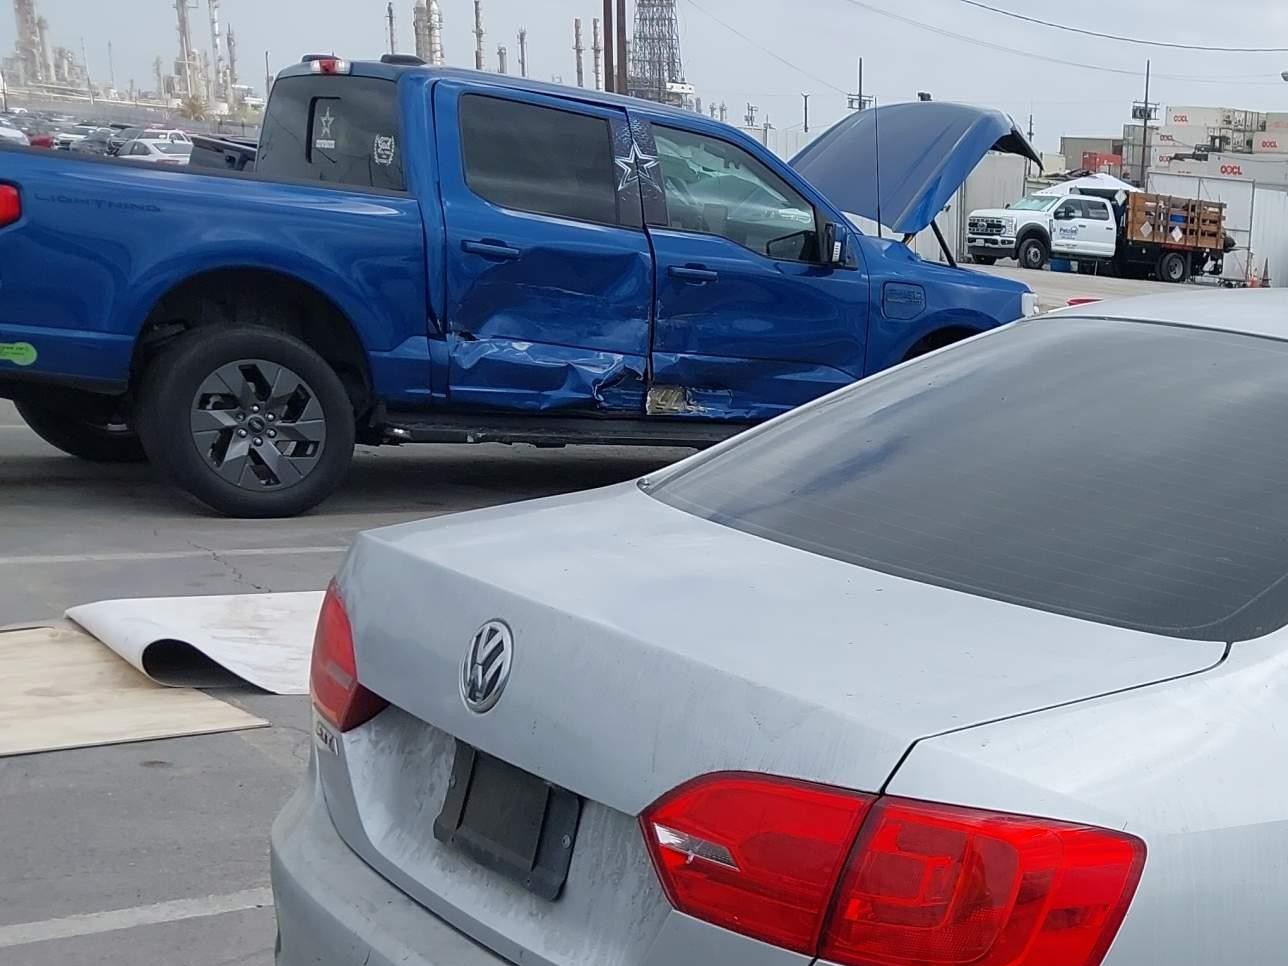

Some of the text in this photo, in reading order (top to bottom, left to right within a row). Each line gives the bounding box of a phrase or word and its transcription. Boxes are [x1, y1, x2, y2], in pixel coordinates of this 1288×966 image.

[1262, 140, 1278, 149] OOCL
[1220, 165, 1243, 176] OOCL
[34, 193, 161, 212] LIGHTNING
